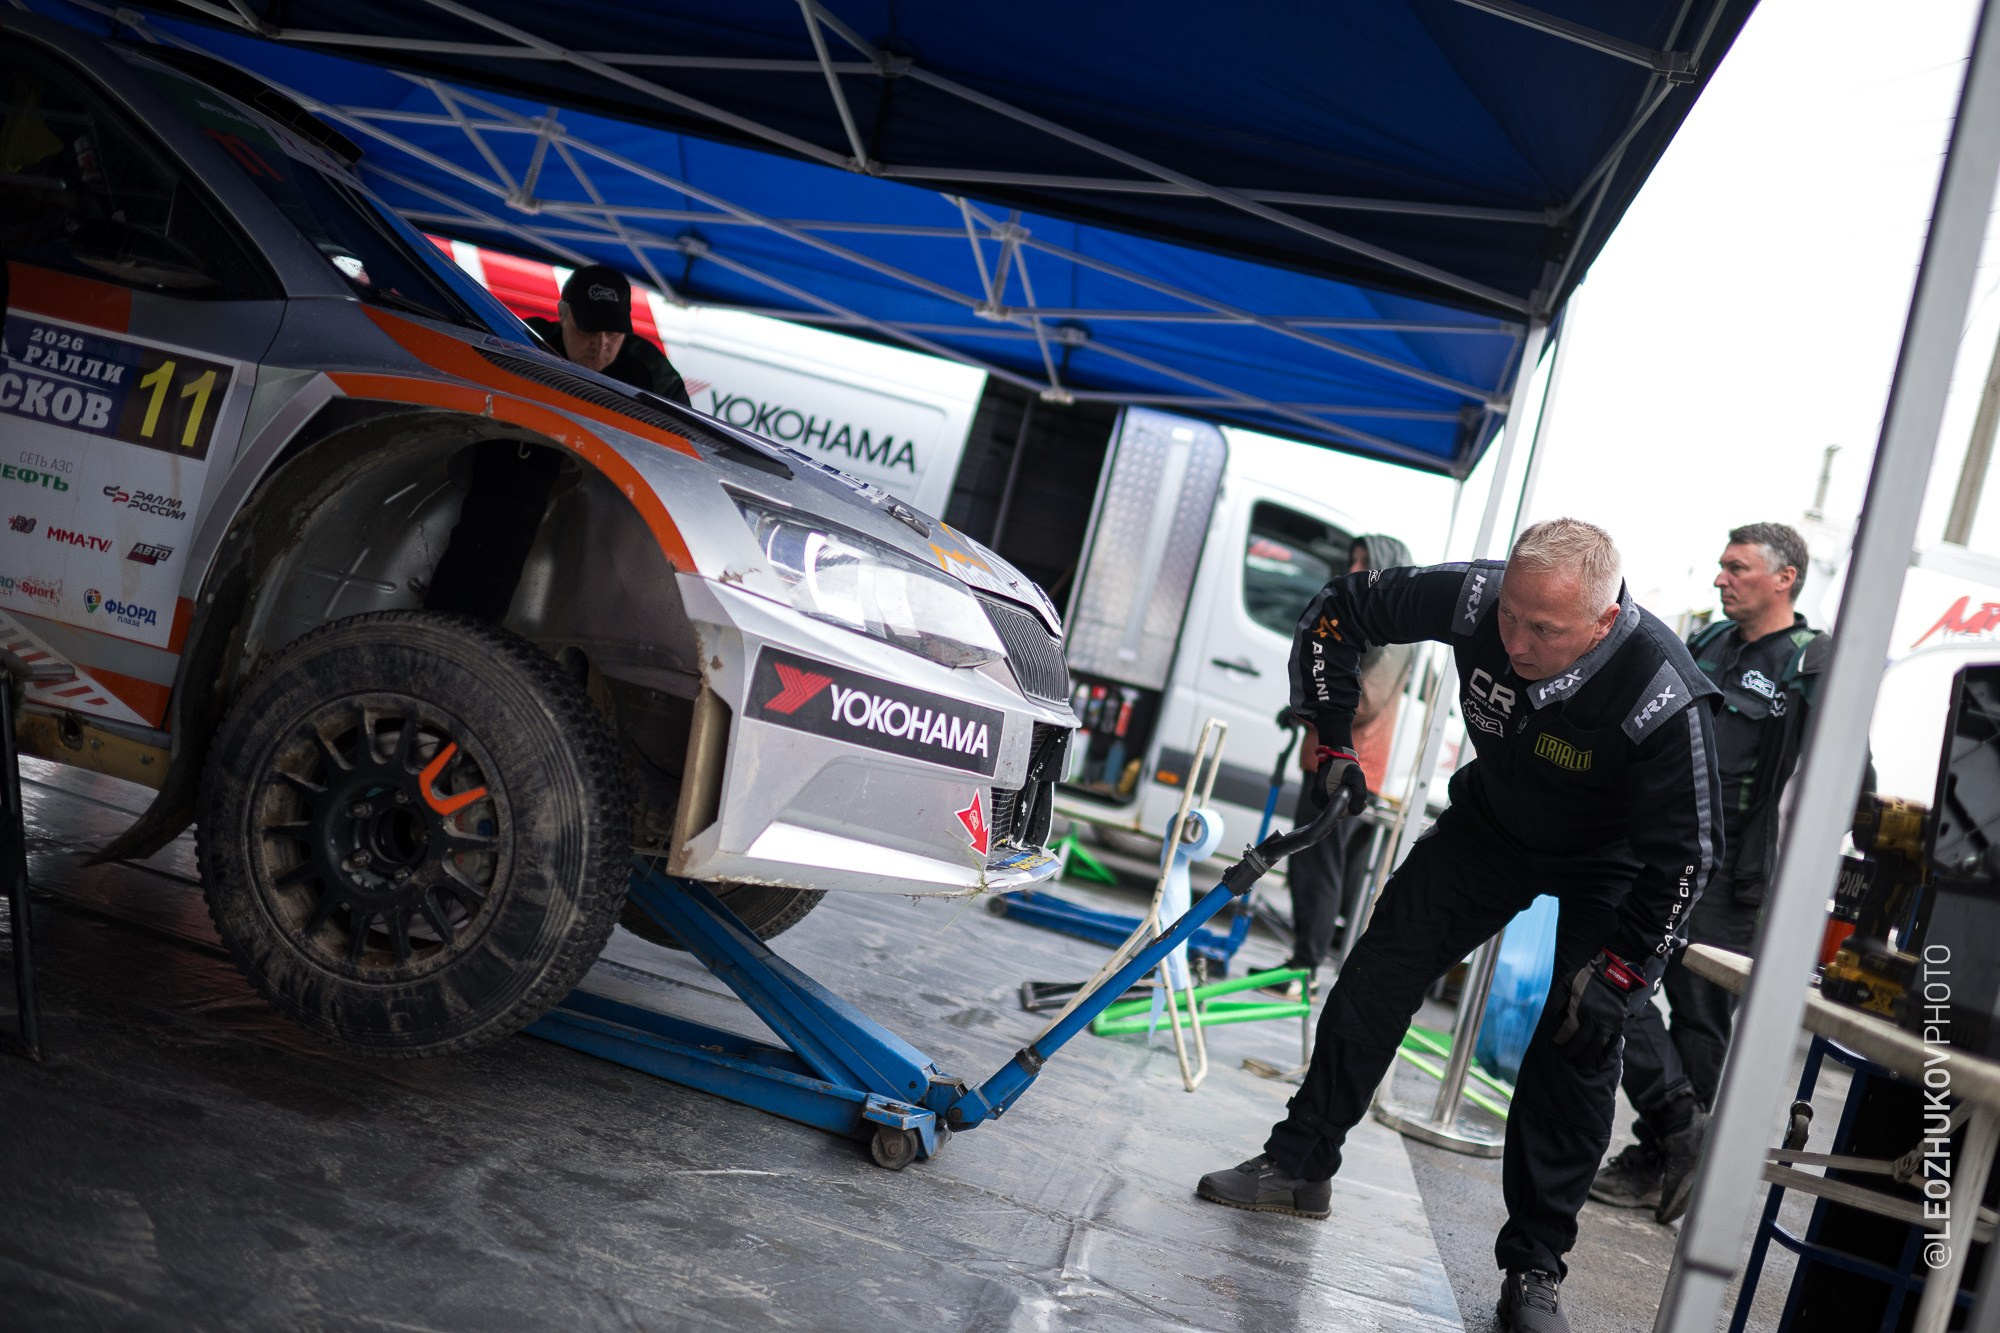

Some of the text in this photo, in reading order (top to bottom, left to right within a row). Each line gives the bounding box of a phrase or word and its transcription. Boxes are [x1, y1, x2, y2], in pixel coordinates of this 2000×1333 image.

[30, 328, 84, 351] 2026
[22, 345, 125, 384] РАЛЛИ
[140, 360, 217, 448] 11
[711, 390, 915, 474] YOKOHAMA
[20, 451, 74, 474] СЕТЬ АЗС
[0, 463, 69, 492] ЕФТЬ
[127, 500, 186, 521] РОССИИ
[132, 490, 182, 509] РАЛЛИ
[21, 581, 55, 600] Sport
[1464, 574, 1487, 624] HRX
[105, 599, 157, 626] ФЬОРД
[117, 615, 140, 627] плаза
[1469, 667, 1516, 714] CR
[1538, 668, 1582, 701] HRX
[830, 684, 989, 758] YOKOHAMA
[1467, 707, 1498, 731] VRC
[1487, 704, 1510, 720] RACING
[1633, 684, 1677, 729] HRX
[1540, 735, 1590, 769] TRIALLI
